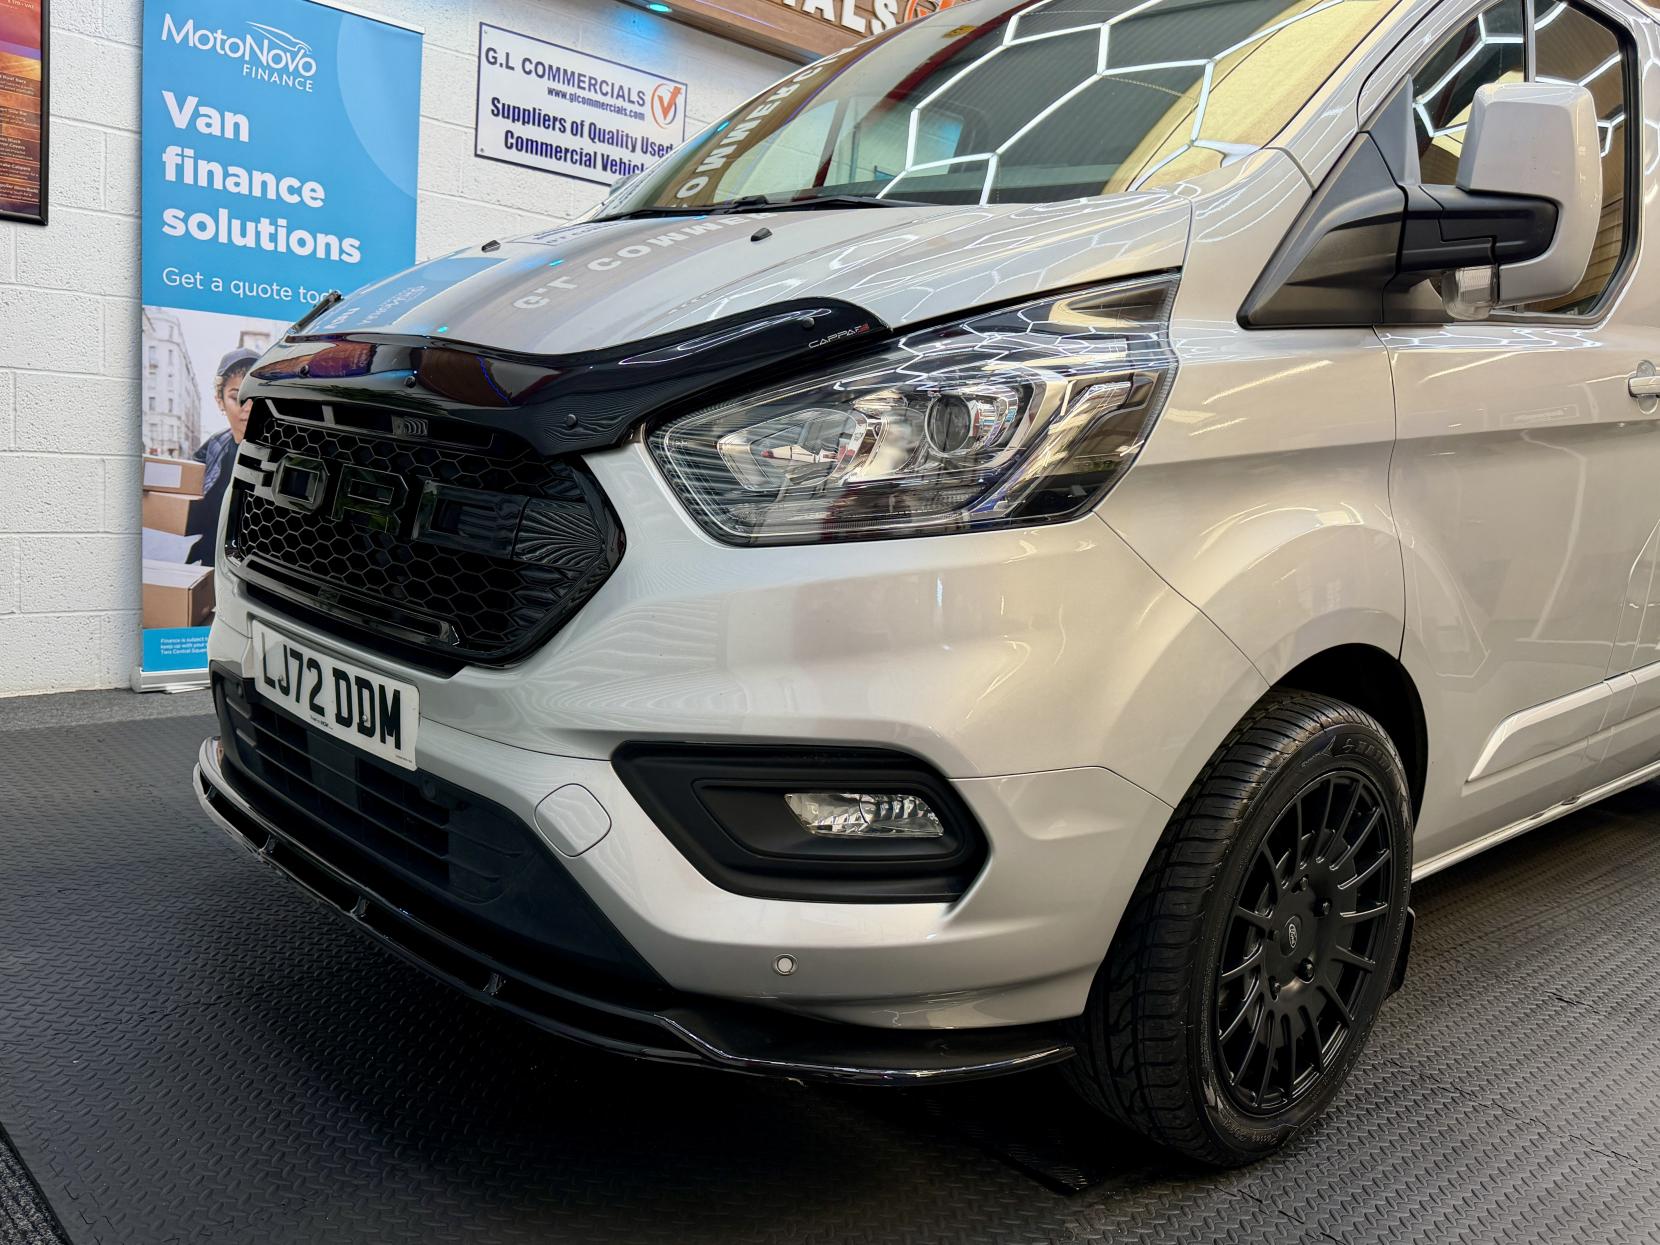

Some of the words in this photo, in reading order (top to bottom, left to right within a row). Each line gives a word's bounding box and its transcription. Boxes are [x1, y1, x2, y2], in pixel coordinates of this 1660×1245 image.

[161, 13, 316, 77] MotoNovo
[243, 64, 313, 92] FINANCE
[484, 46, 515, 71] G.L
[521, 57, 646, 107] COMMERCIALS
[547, 86, 645, 121] www.glcommercials.com
[162, 90, 249, 142] Van
[491, 96, 566, 134] Suppliers
[570, 119, 585, 143] of
[588, 121, 637, 153] Quality
[162, 145, 325, 208] finance
[504, 129, 597, 169] Commercial
[600, 152, 648, 177] Vehicl
[161, 207, 361, 264] solutions
[162, 267, 204, 289] Get
[211, 277, 223, 292] a
[230, 280, 292, 300] quote
[261, 631, 325, 718] LJ72
[332, 666, 402, 751] DDM
